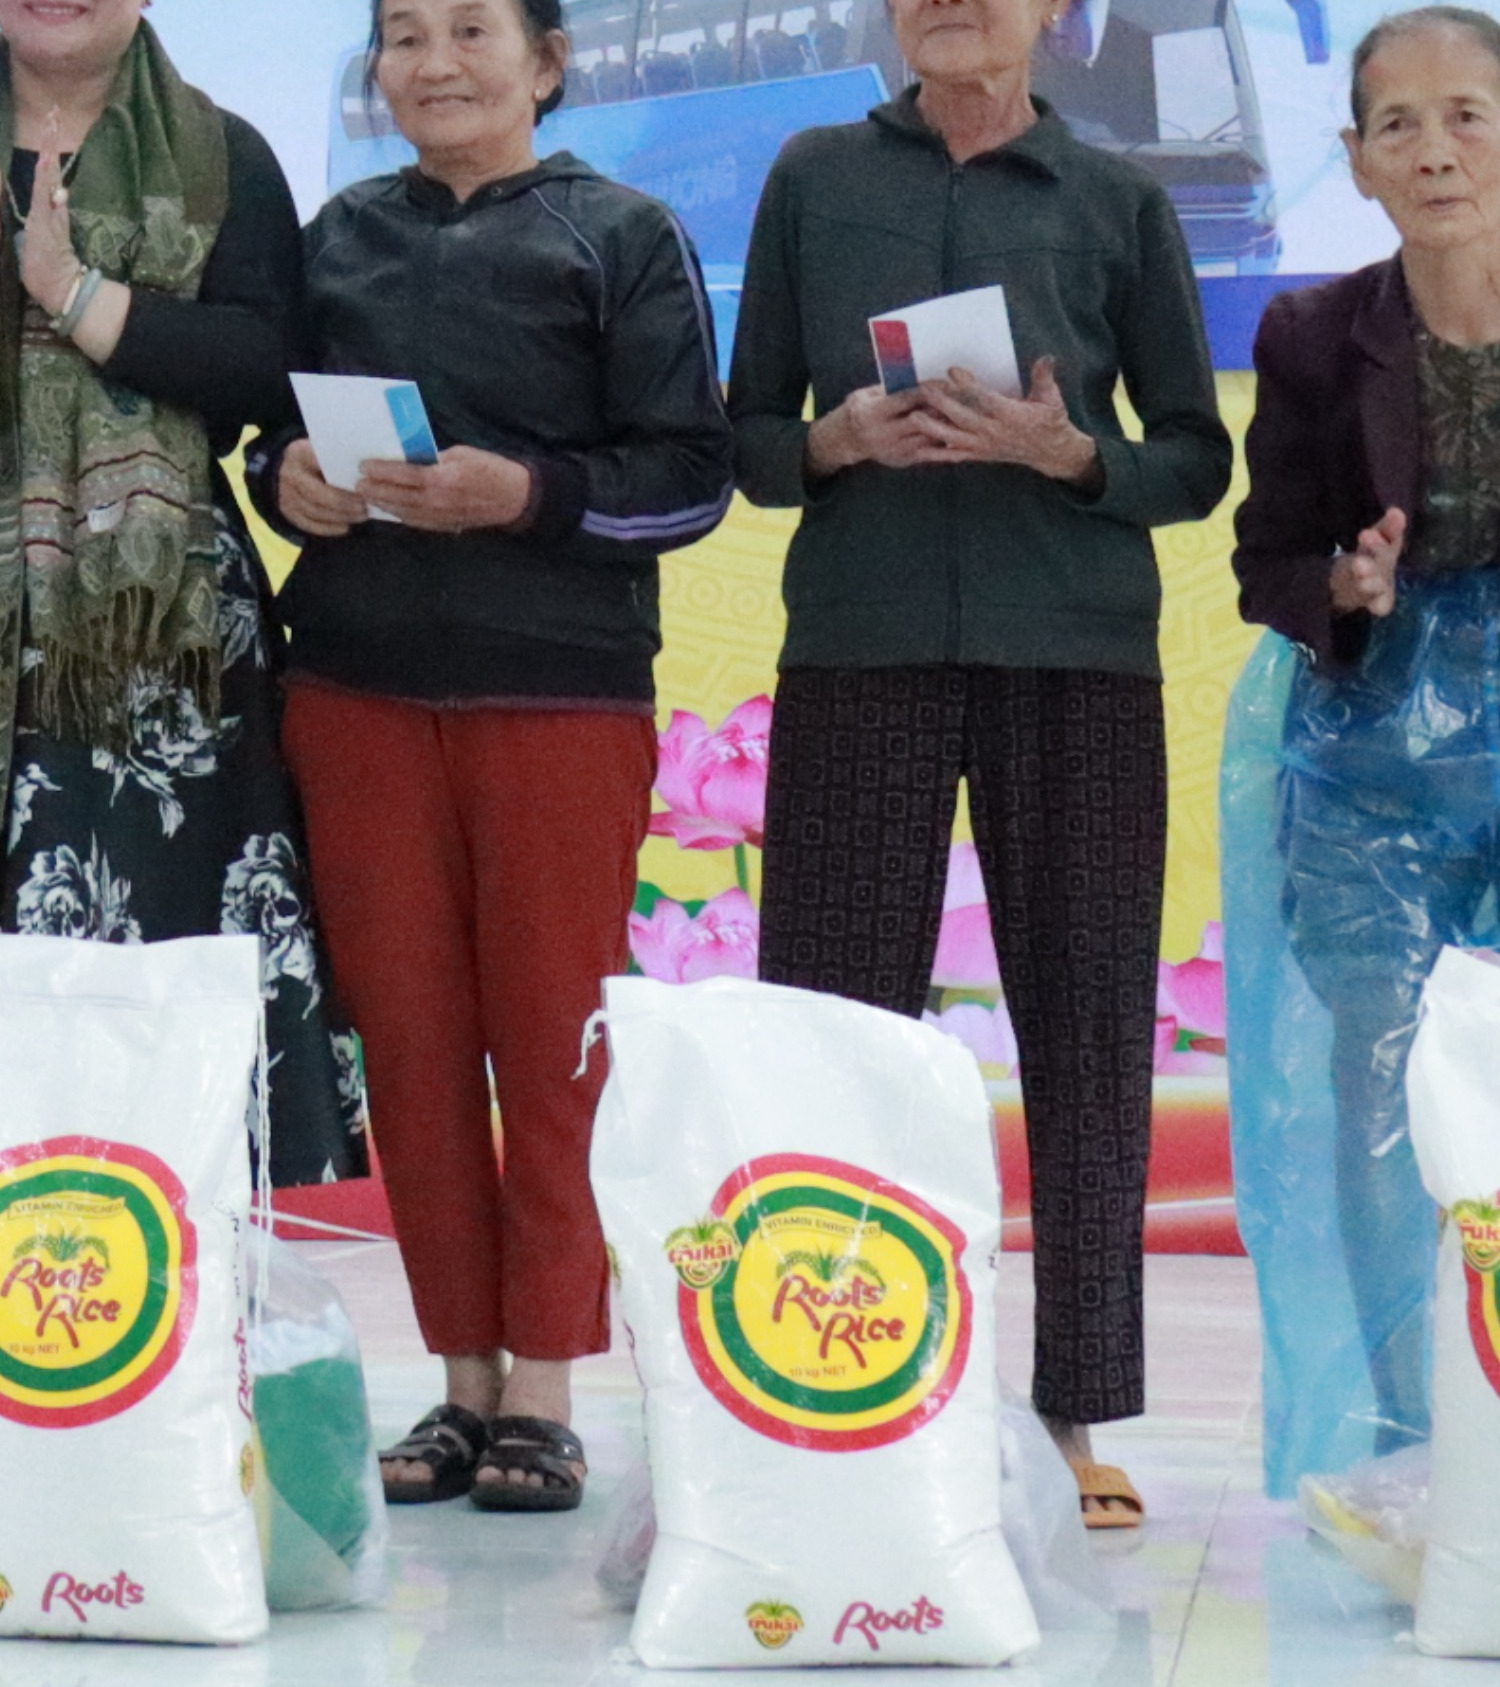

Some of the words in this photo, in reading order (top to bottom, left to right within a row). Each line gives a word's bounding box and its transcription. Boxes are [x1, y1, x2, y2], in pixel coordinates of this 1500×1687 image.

[0, 1256, 106, 1311] Roots
[772, 1274, 884, 1332] Roots
[36, 1294, 121, 1349] Rice
[819, 1311, 906, 1369] Rice
[822, 1365, 847, 1377] NET
[41, 1569, 145, 1623] Roots
[832, 1594, 944, 1651] Roots
